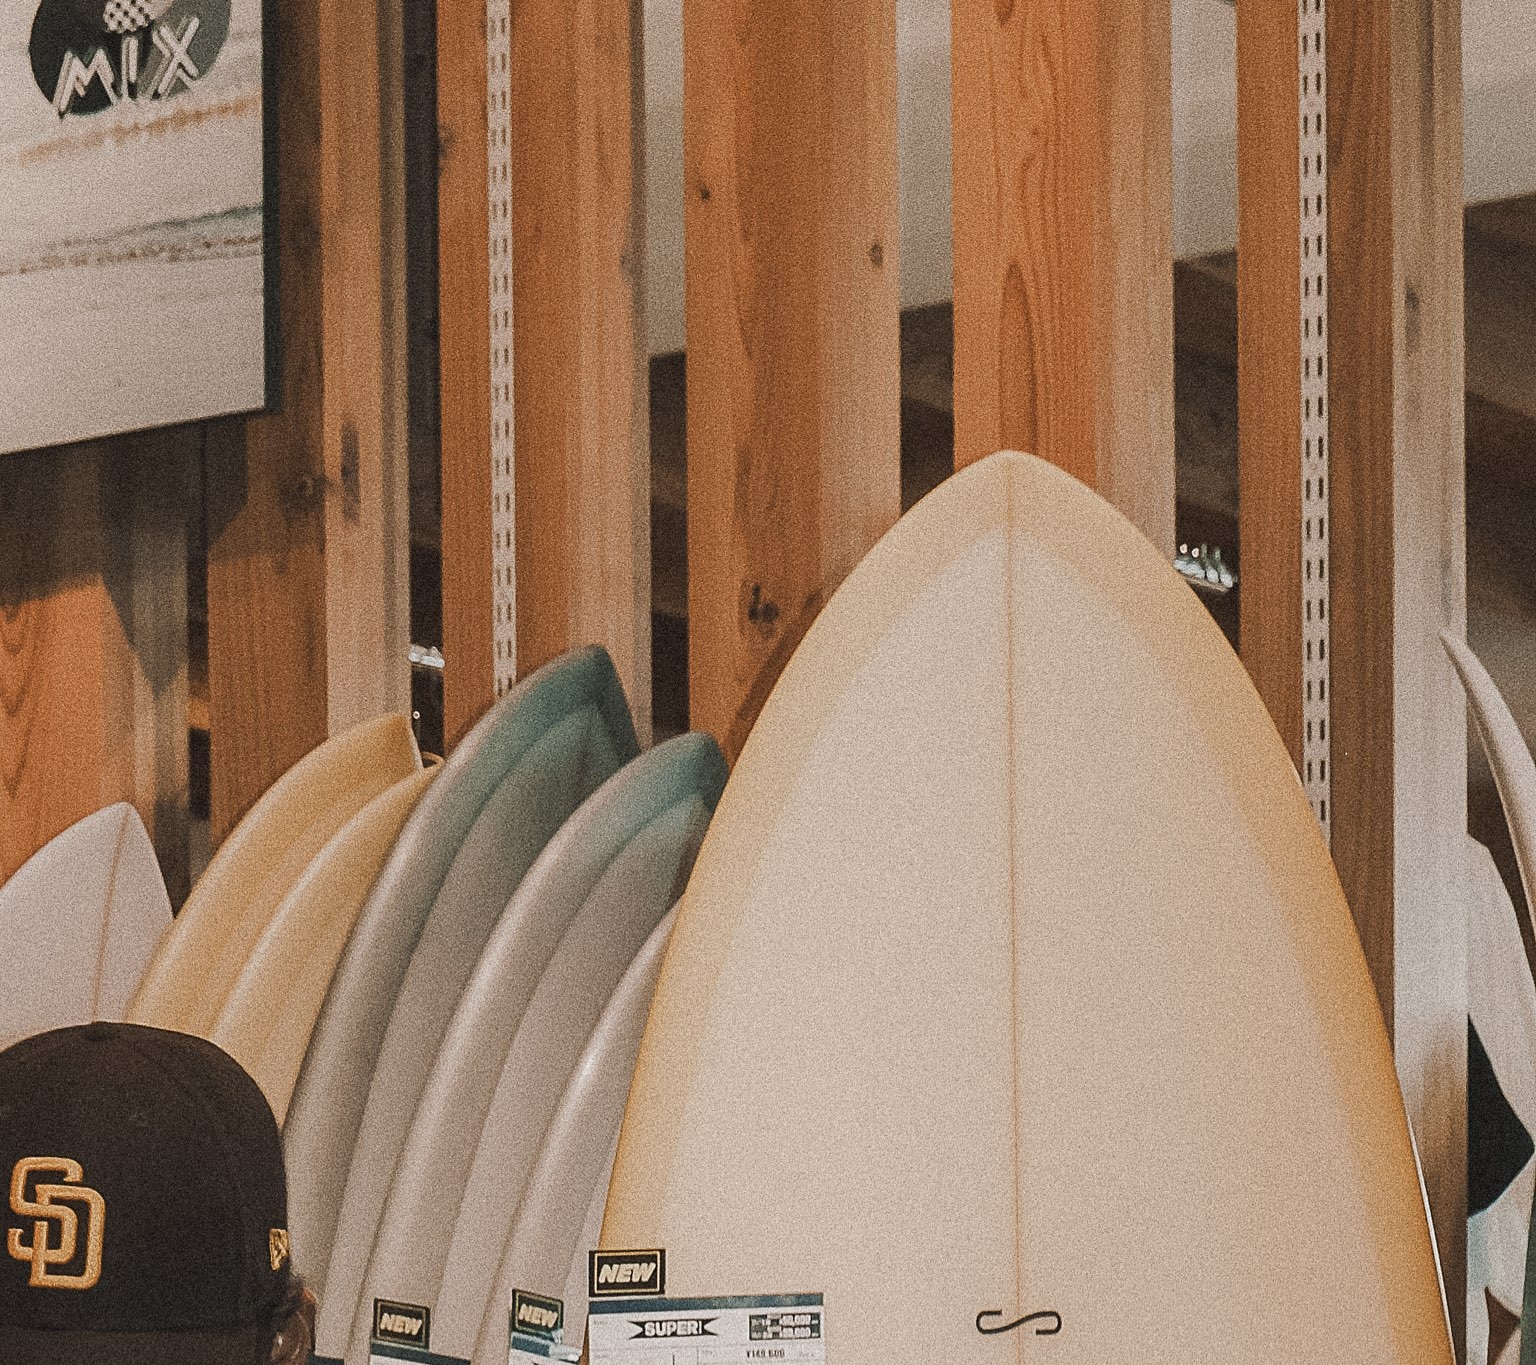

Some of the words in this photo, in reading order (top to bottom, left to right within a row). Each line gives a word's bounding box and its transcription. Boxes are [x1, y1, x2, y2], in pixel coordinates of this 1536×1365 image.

[52, 14, 202, 118] MIX
[7, 1156, 106, 1290] SD
[598, 1261, 656, 1284] NEW
[379, 1312, 423, 1335] NEW
[518, 1303, 558, 1328] NEW
